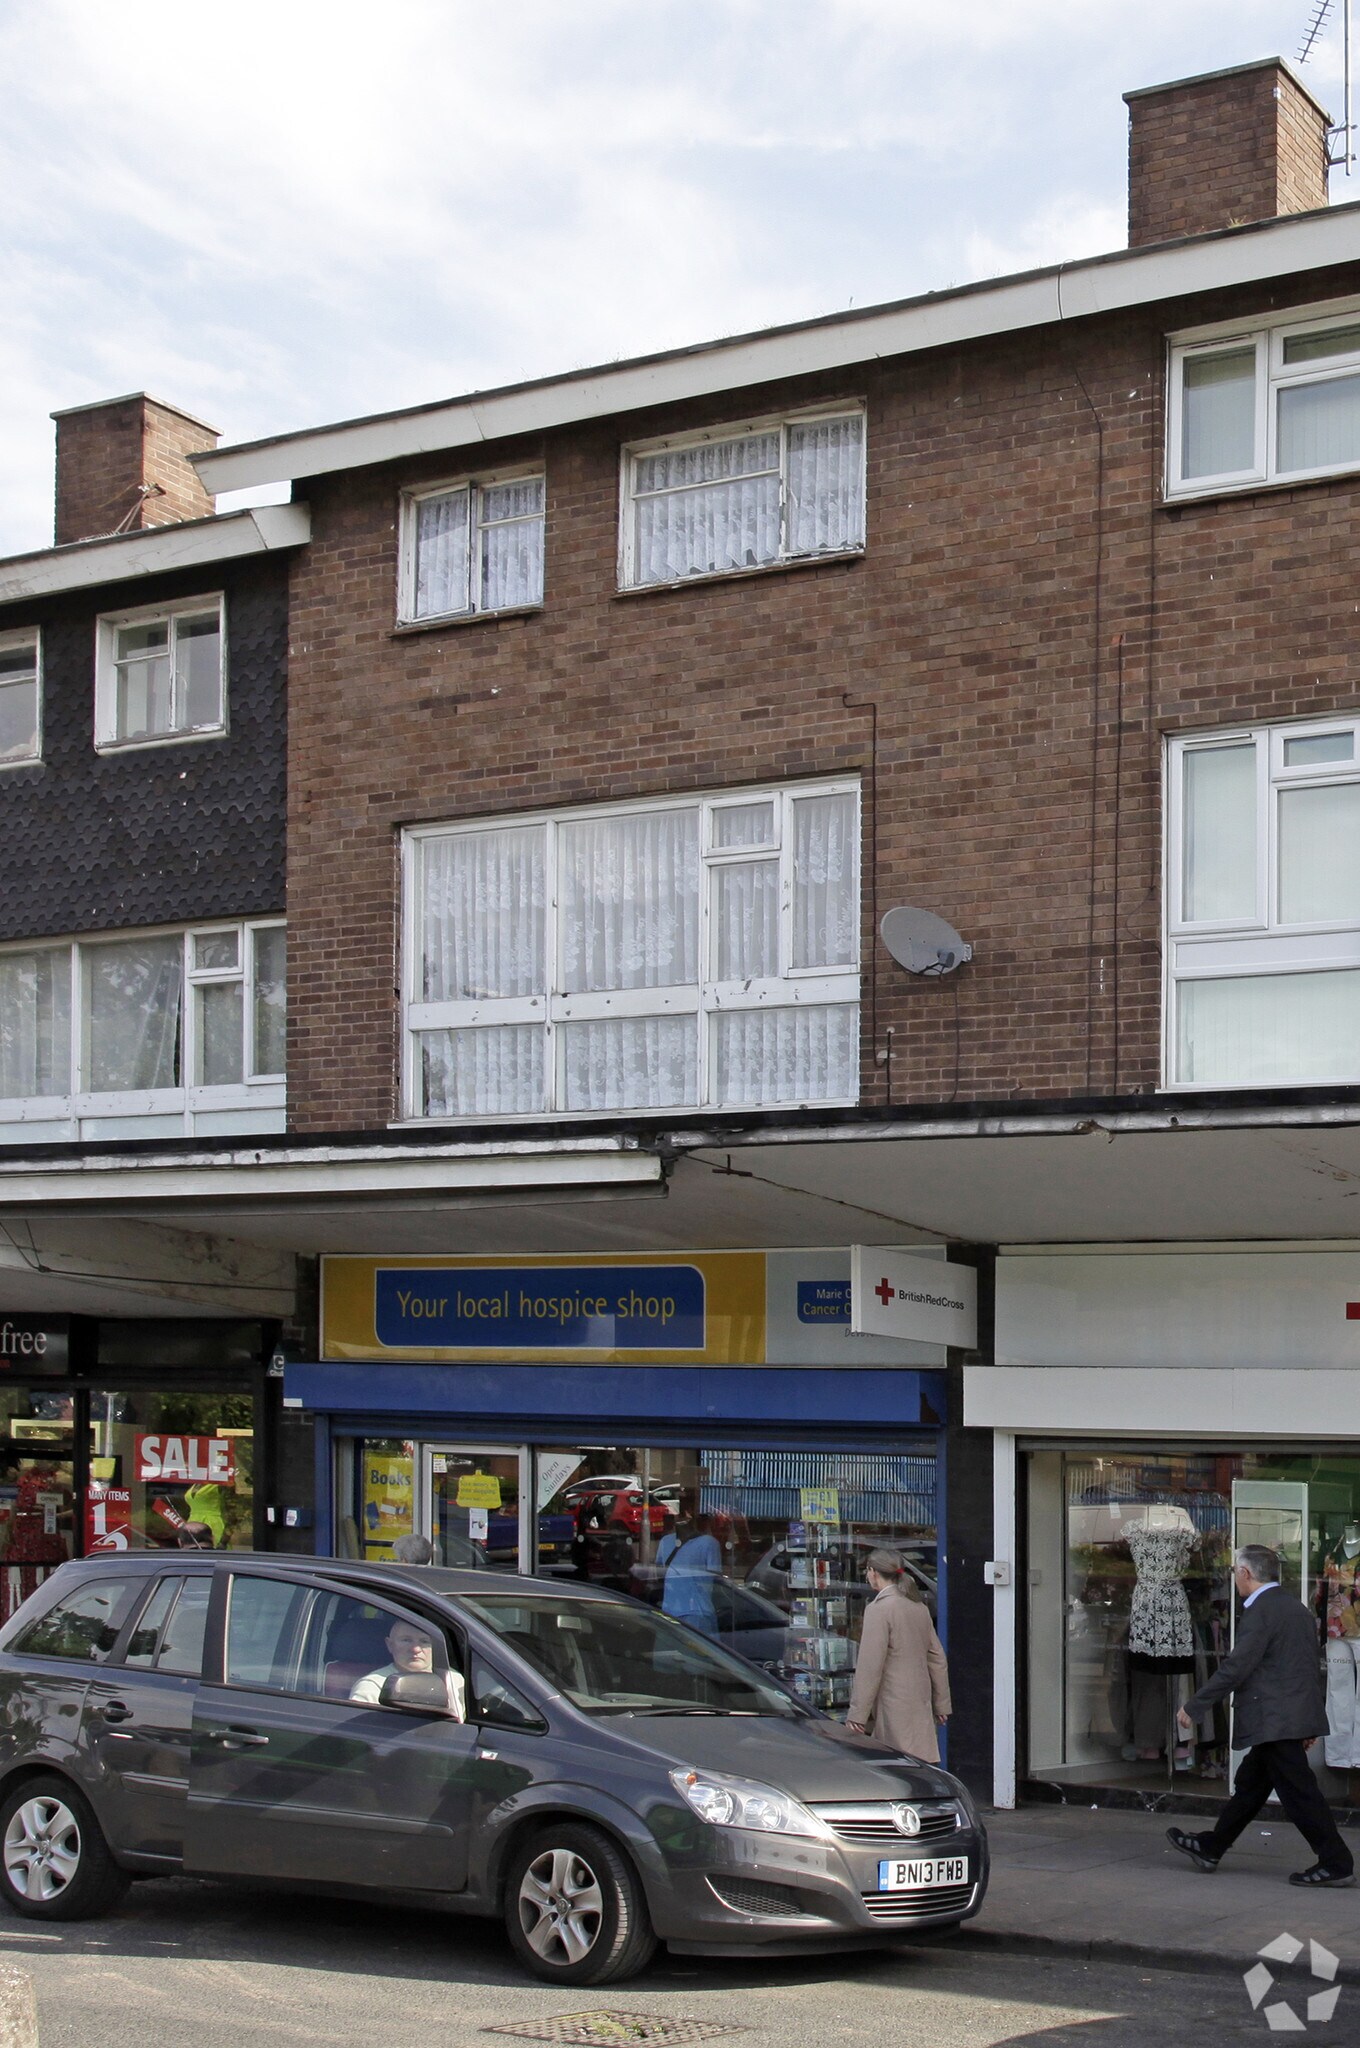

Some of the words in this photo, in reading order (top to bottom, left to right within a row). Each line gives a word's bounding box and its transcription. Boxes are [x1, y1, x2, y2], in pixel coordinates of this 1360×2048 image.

[816, 1288, 842, 1299] Marie
[397, 1291, 447, 1318] Your
[457, 1290, 508, 1318] local
[519, 1289, 607, 1325] hospice
[617, 1289, 675, 1325] shop
[803, 1304, 840, 1315] Cancer
[1, 1322, 48, 1354] free
[141, 1436, 229, 1481] SALE
[371, 1470, 411, 1486] Books
[542, 1461, 559, 1482] Open
[544, 1464, 571, 1496] Sundays
[88, 1490, 108, 1500] MANY
[109, 1491, 130, 1501] ITEMS
[896, 1863, 933, 1884] BN13
[937, 1860, 963, 1881] FWB
